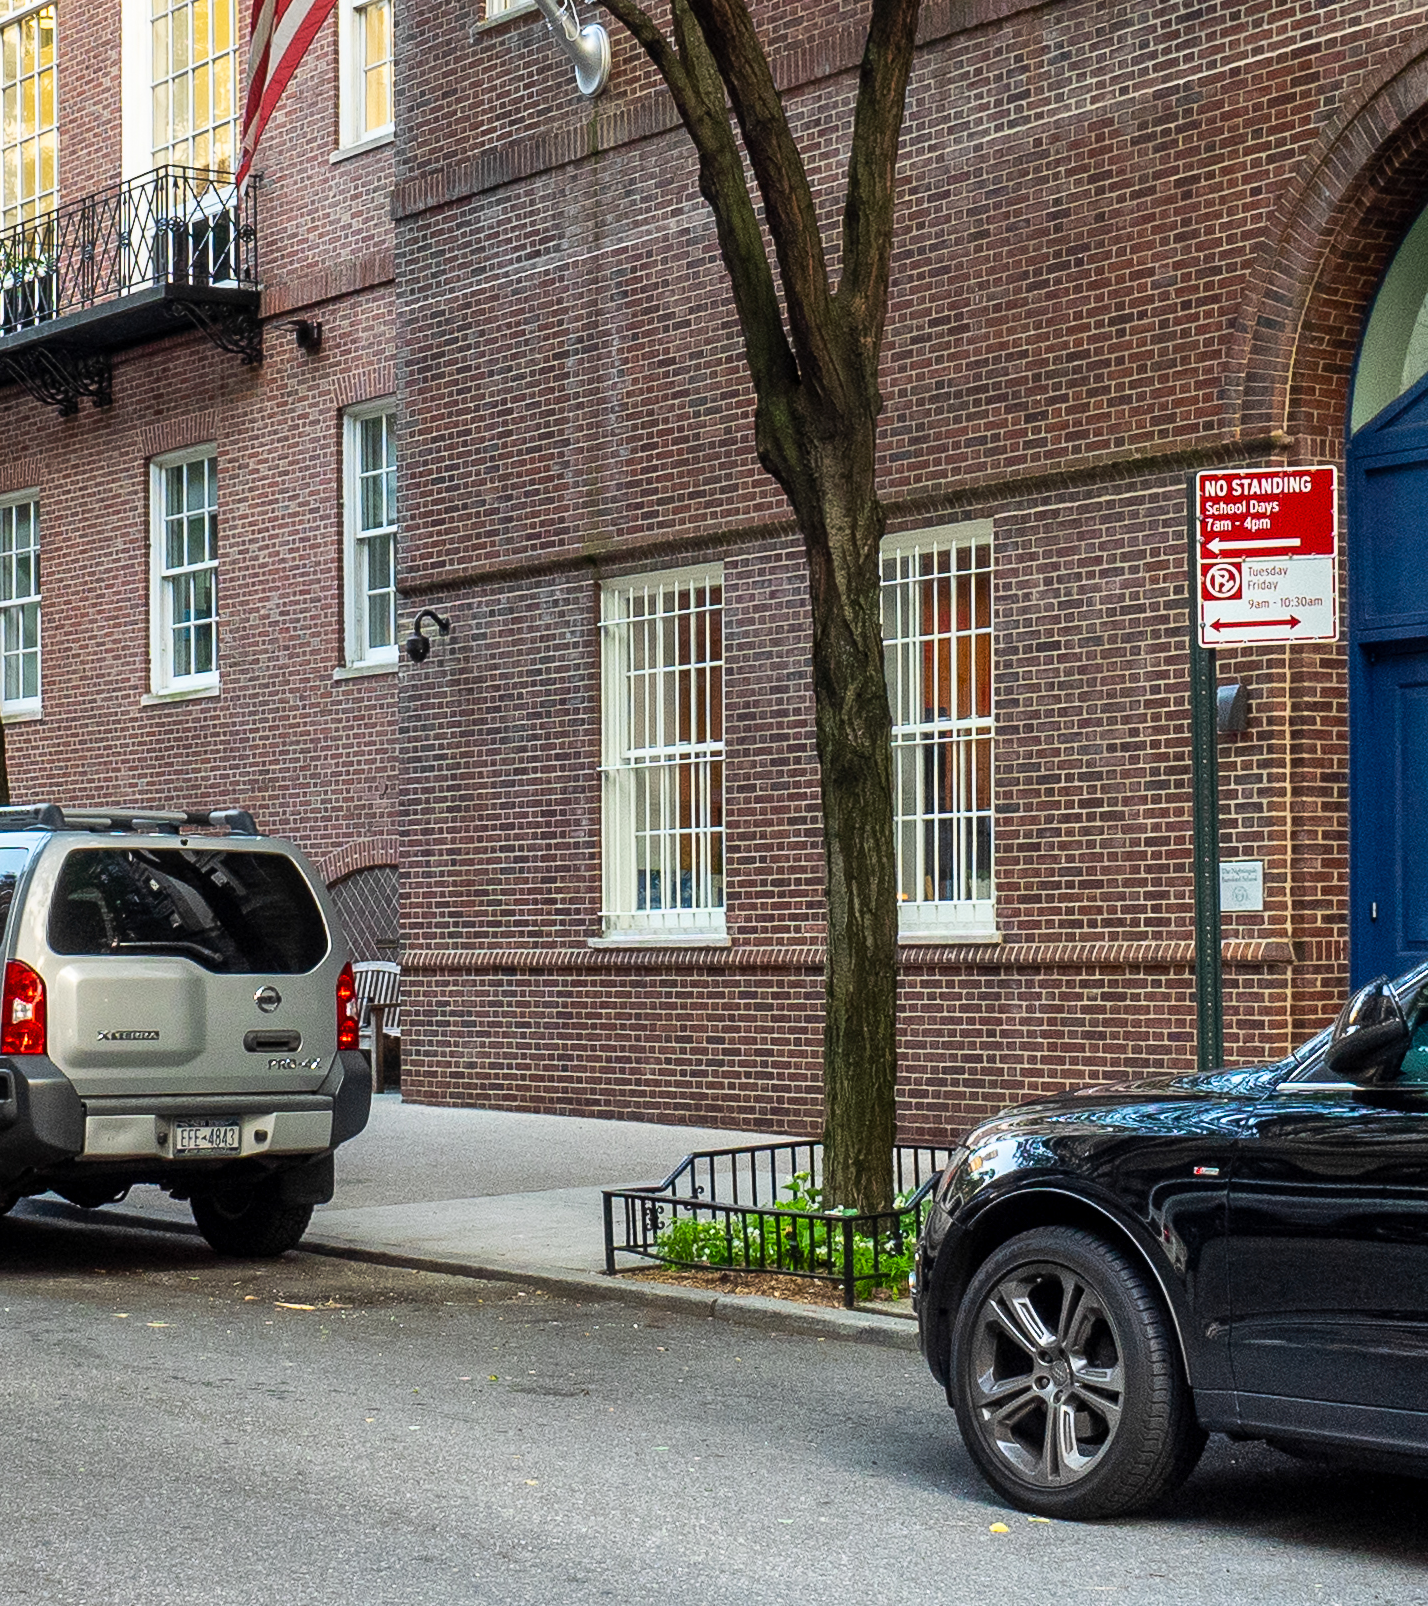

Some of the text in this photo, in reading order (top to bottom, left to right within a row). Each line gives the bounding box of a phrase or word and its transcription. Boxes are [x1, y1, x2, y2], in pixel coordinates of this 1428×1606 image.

[1204, 475, 1312, 498] NO STANDING
[1205, 499, 1280, 516] School Days
[1205, 518, 1232, 532] 7am
[1243, 516, 1271, 532] 4pm
[1248, 565, 1289, 578] Tuesday
[1247, 579, 1279, 592] Friday
[1248, 598, 1270, 610] 9am
[1279, 596, 1324, 608] 10:30am
